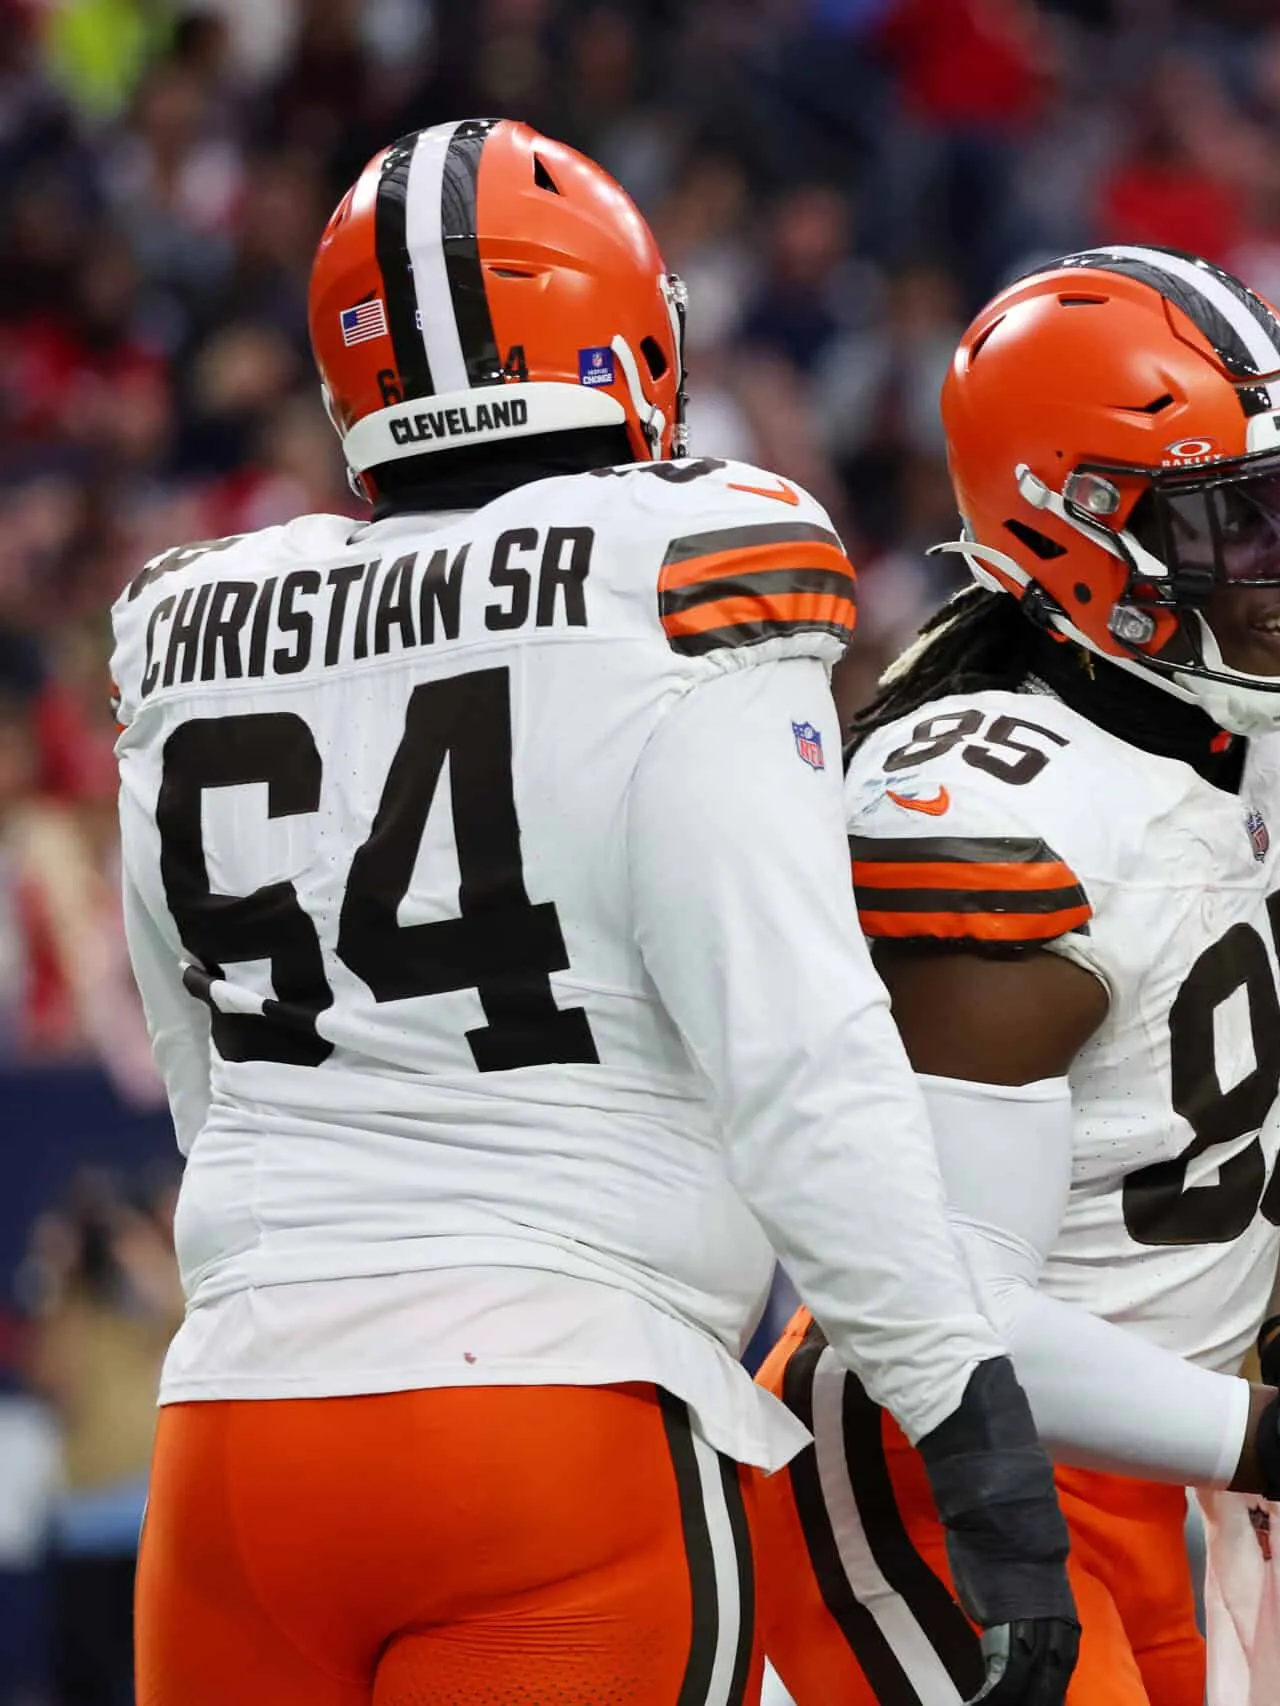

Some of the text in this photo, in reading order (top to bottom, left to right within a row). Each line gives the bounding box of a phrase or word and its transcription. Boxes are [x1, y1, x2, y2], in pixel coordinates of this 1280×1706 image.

[389, 398, 528, 445] CLEVELAND
[142, 543, 473, 695] CHRISTIAN
[485, 525, 596, 631] SR
[882, 708, 1070, 786] 85
[157, 666, 601, 1073] 64
